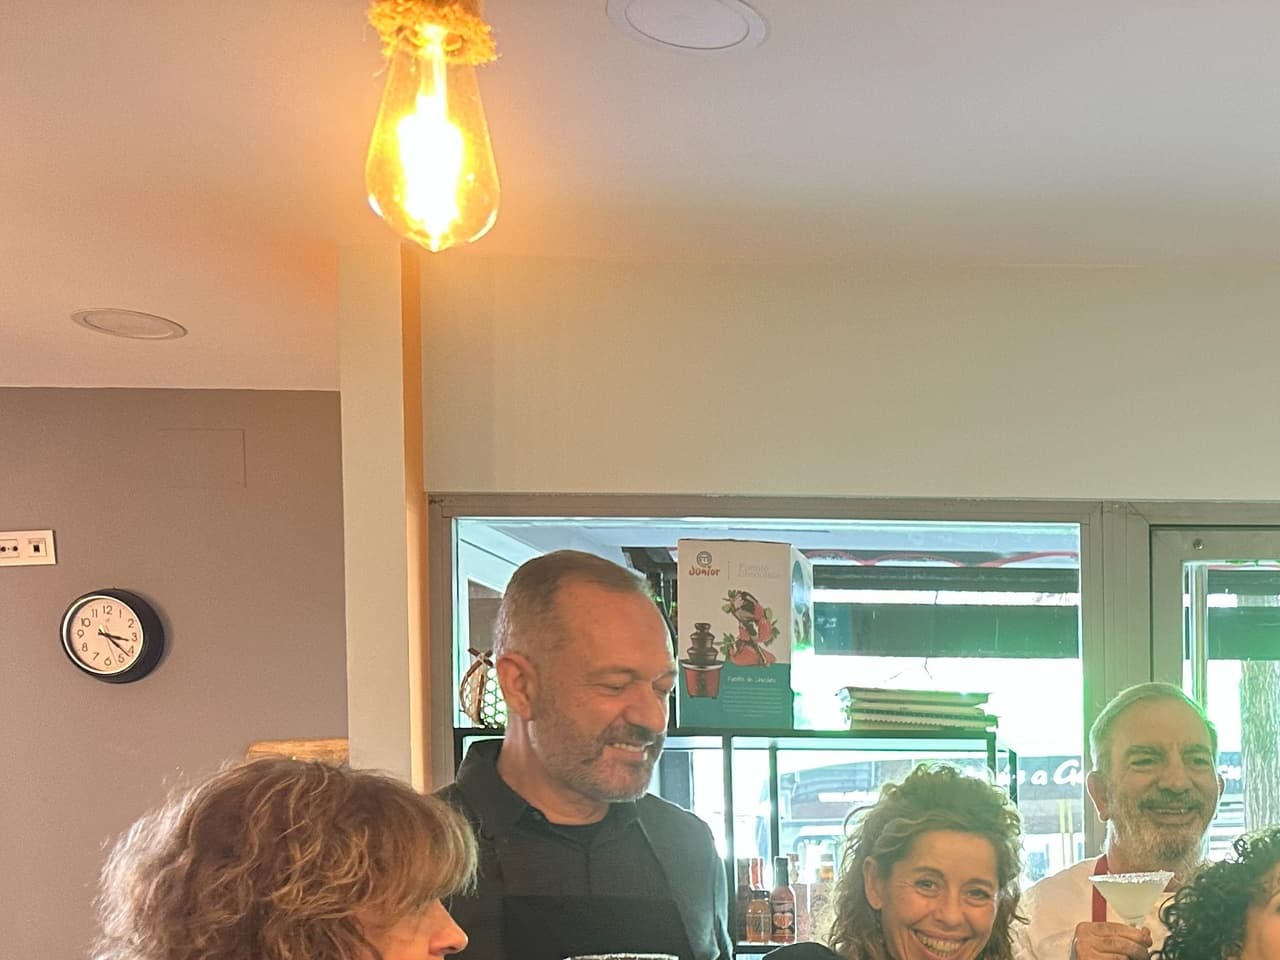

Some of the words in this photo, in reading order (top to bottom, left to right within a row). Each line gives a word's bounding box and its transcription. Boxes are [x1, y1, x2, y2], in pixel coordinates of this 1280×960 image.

[91, 608, 98, 619] 11
[102, 604, 113, 616] 12
[80, 617, 91, 628] 10
[127, 618, 135, 629] 2
[77, 629, 84, 639] 9
[131, 632, 137, 641] 3
[81, 642, 89, 652] 8
[127, 644, 135, 655] 4
[93, 652, 99, 660] 7
[104, 656, 112, 666] 6
[118, 654, 125, 663] 5
